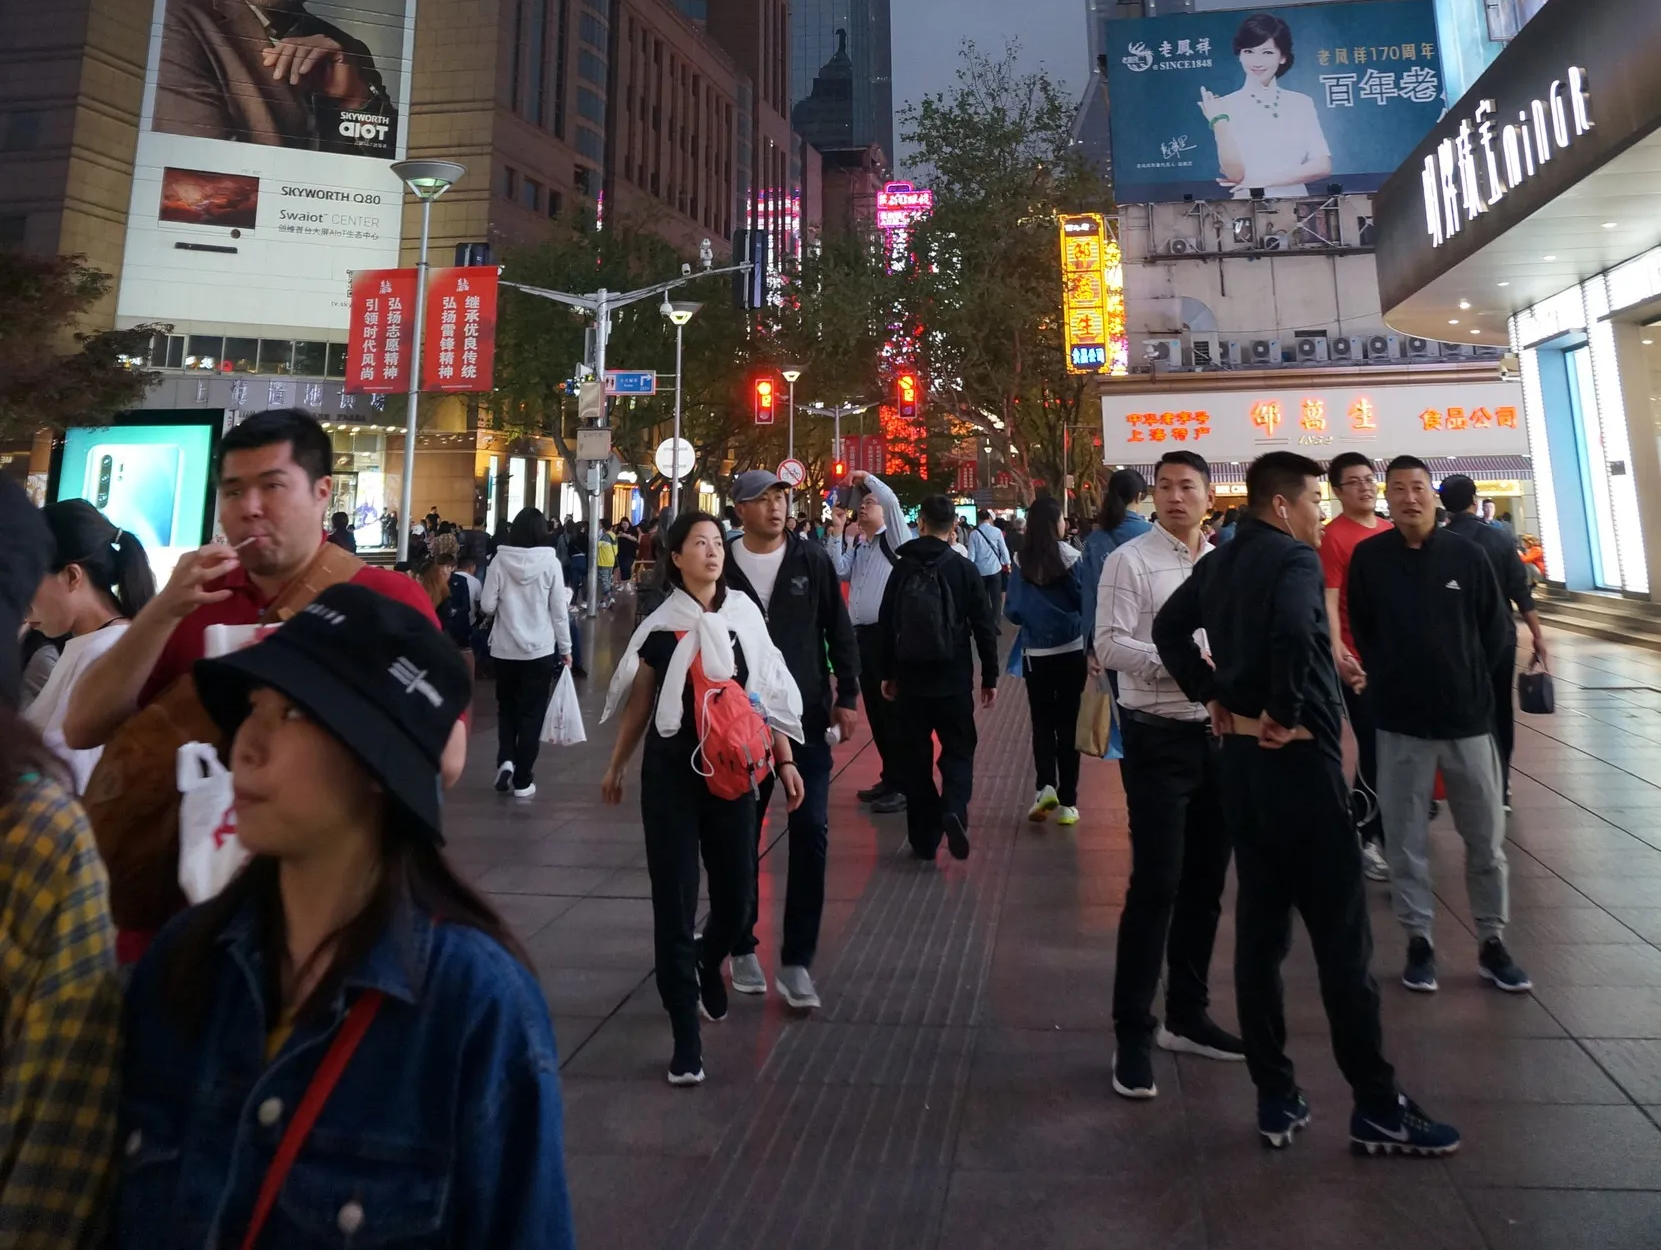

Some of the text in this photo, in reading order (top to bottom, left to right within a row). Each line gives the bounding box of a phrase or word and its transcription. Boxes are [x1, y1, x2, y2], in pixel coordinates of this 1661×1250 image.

[1317, 42, 1435, 66] 老凤祥170周年
[1319, 66, 1448, 123] 百年老
[340, 111, 390, 125] SKYWORTH
[281, 186, 381, 205] SKYWORTH Q80
[331, 213, 380, 228] CENTER
[360, 297, 379, 381] 引领时代风尚
[383, 296, 402, 380] 弘扬志愿精神
[438, 295, 457, 379] 弘扬雷锋精神
[460, 295, 480, 379] 继承优良传统
[1420, 406, 1518, 431] 食品公司
